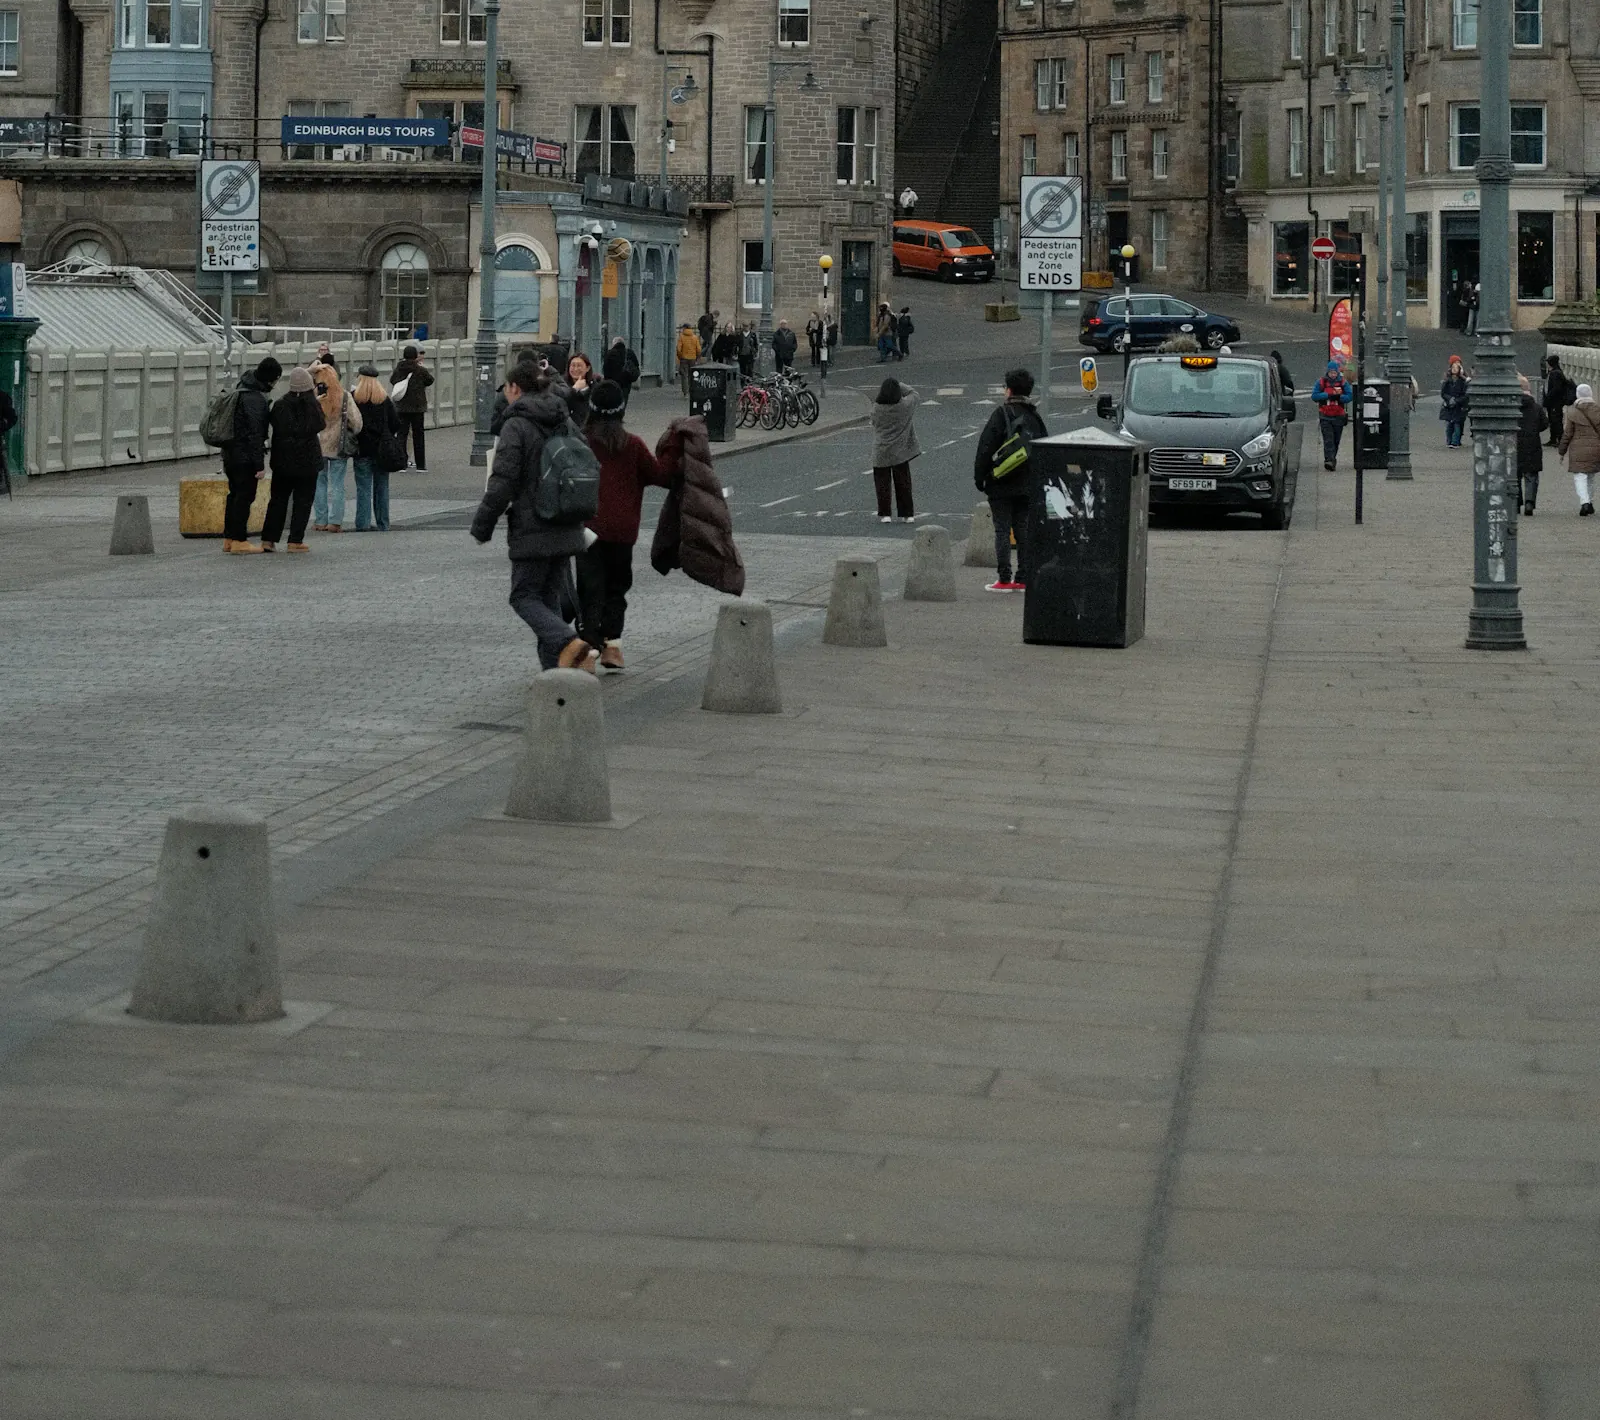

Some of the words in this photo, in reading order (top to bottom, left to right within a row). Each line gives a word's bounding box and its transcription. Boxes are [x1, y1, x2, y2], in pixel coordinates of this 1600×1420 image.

[294, 125, 364, 136] EDINBURGH
[367, 126, 391, 137] BUS
[394, 127, 435, 137] TOURS
[205, 223, 256, 231] Pedestrian
[227, 233, 252, 242] cycle
[219, 241, 242, 251] Zone
[1024, 241, 1077, 249] Pedestrian
[1027, 251, 1046, 259] and
[1047, 251, 1074, 260] cycle
[1038, 261, 1062, 270] Zone
[1028, 273, 1073, 285] ENDS
[1189, 357, 1210, 366] TAXI
[1246, 455, 1273, 472] TAXI
[1172, 480, 1194, 489] SF69
